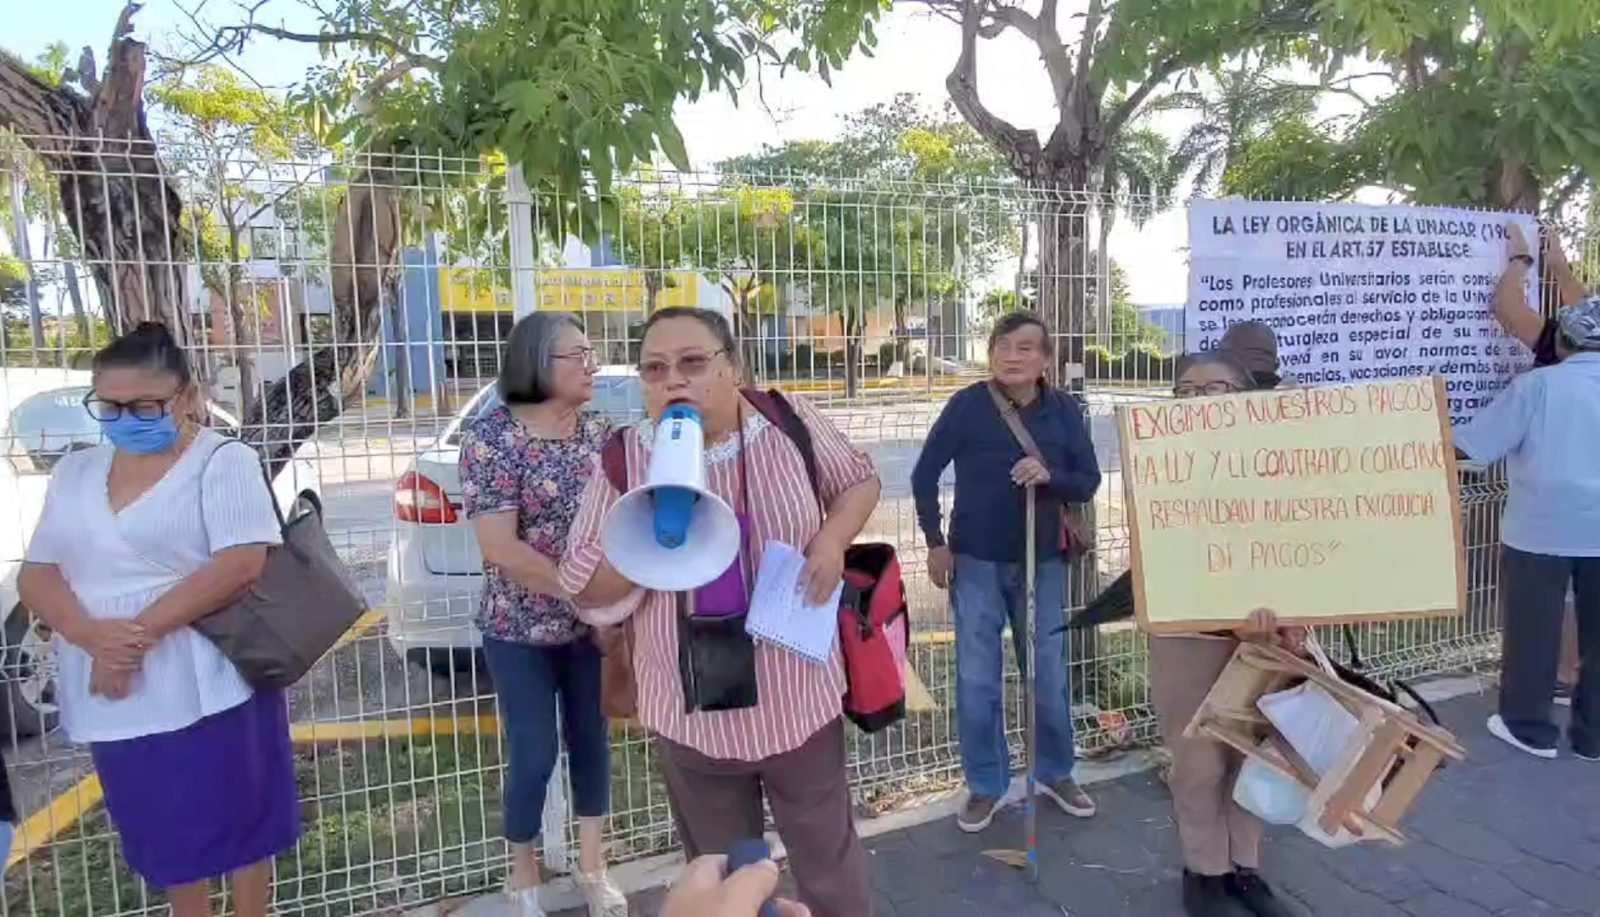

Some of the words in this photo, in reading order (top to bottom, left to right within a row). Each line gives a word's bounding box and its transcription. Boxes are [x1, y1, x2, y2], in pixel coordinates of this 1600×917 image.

[1213, 216, 1235, 235] LA
[1243, 215, 1270, 234] LEY
[1370, 216, 1390, 234] DE
[1394, 217, 1412, 235] LA
[1416, 219, 1477, 238] UNACAR
[1286, 241, 1307, 259] EN
[1312, 241, 1326, 258] EL
[1243, 273, 1313, 291] Profesores
[1320, 270, 1410, 287] Universitarios
[1419, 269, 1455, 286] serán
[1198, 299, 1245, 312] como
[1251, 291, 1342, 314] profesionales
[1346, 291, 1358, 306] al
[1362, 289, 1417, 305] servicio
[1421, 289, 1440, 304] de
[1446, 290, 1457, 304] la
[1198, 319, 1218, 332] se
[1341, 309, 1401, 325] derechos
[1406, 311, 1416, 324] y
[1199, 335, 1221, 352] de
[1349, 327, 1411, 346] especial
[1421, 326, 1442, 339] de
[1453, 326, 1472, 338] su
[1321, 350, 1339, 364] en
[1349, 349, 1363, 362] su
[1419, 344, 1477, 357] normas
[1485, 343, 1500, 356] de
[1426, 363, 1437, 376] y
[1131, 400, 1237, 441] EXIGIMOS
[1245, 384, 1357, 423] NUESTROS
[1366, 381, 1434, 415] PAGOS
[1133, 452, 1158, 485] LA
[1211, 450, 1222, 480] Y
[1253, 446, 1350, 477] CONTRATO
[1264, 497, 1349, 523] NUESTRA
